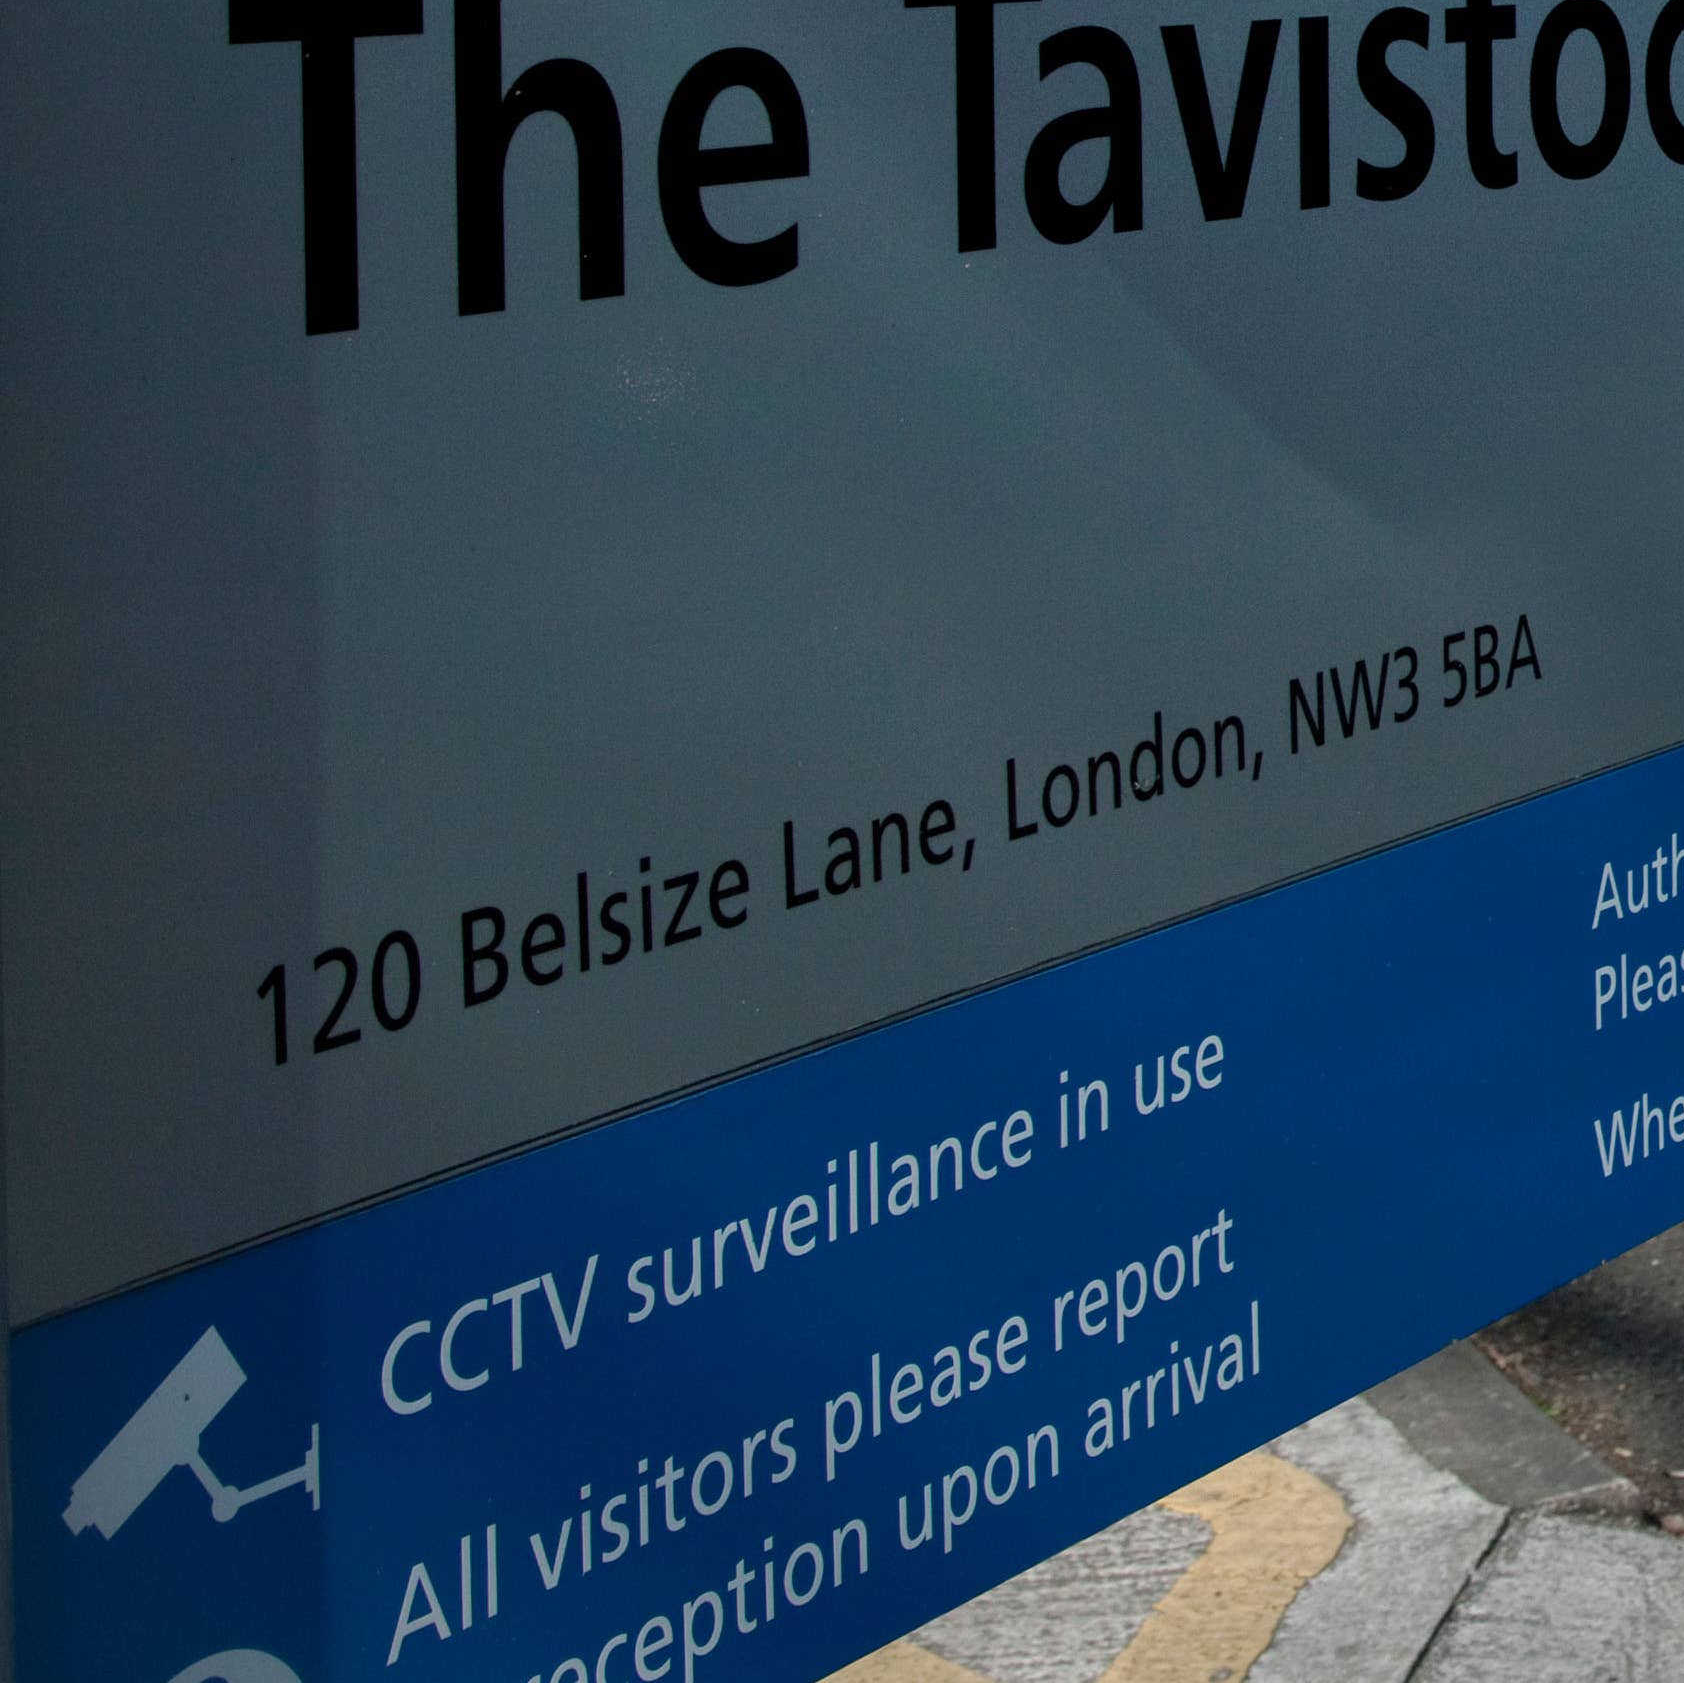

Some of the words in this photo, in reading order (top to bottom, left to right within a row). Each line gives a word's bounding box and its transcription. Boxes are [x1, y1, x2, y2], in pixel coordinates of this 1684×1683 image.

[257, 930, 421, 1066] 120
[461, 857, 749, 1008] Belsize
[784, 800, 975, 909] Lane,
[1007, 711, 1263, 841] London,
[1290, 646, 1419, 754] NW3
[1443, 614, 1542, 708] 5BA
[381, 1255, 598, 1414] CCTV
[628, 1110, 1033, 1323] surveillance
[1060, 1071, 1108, 1148] in
[1135, 1035, 1223, 1115] use
[387, 1525, 497, 1665] All
[530, 1419, 796, 1590] visitors
[826, 1316, 1028, 1481] please
[1054, 1210, 1233, 1351] report
[528, 1519, 868, 1683] ception
[899, 1425, 1058, 1553] upon
[1085, 1301, 1259, 1457] arrival
